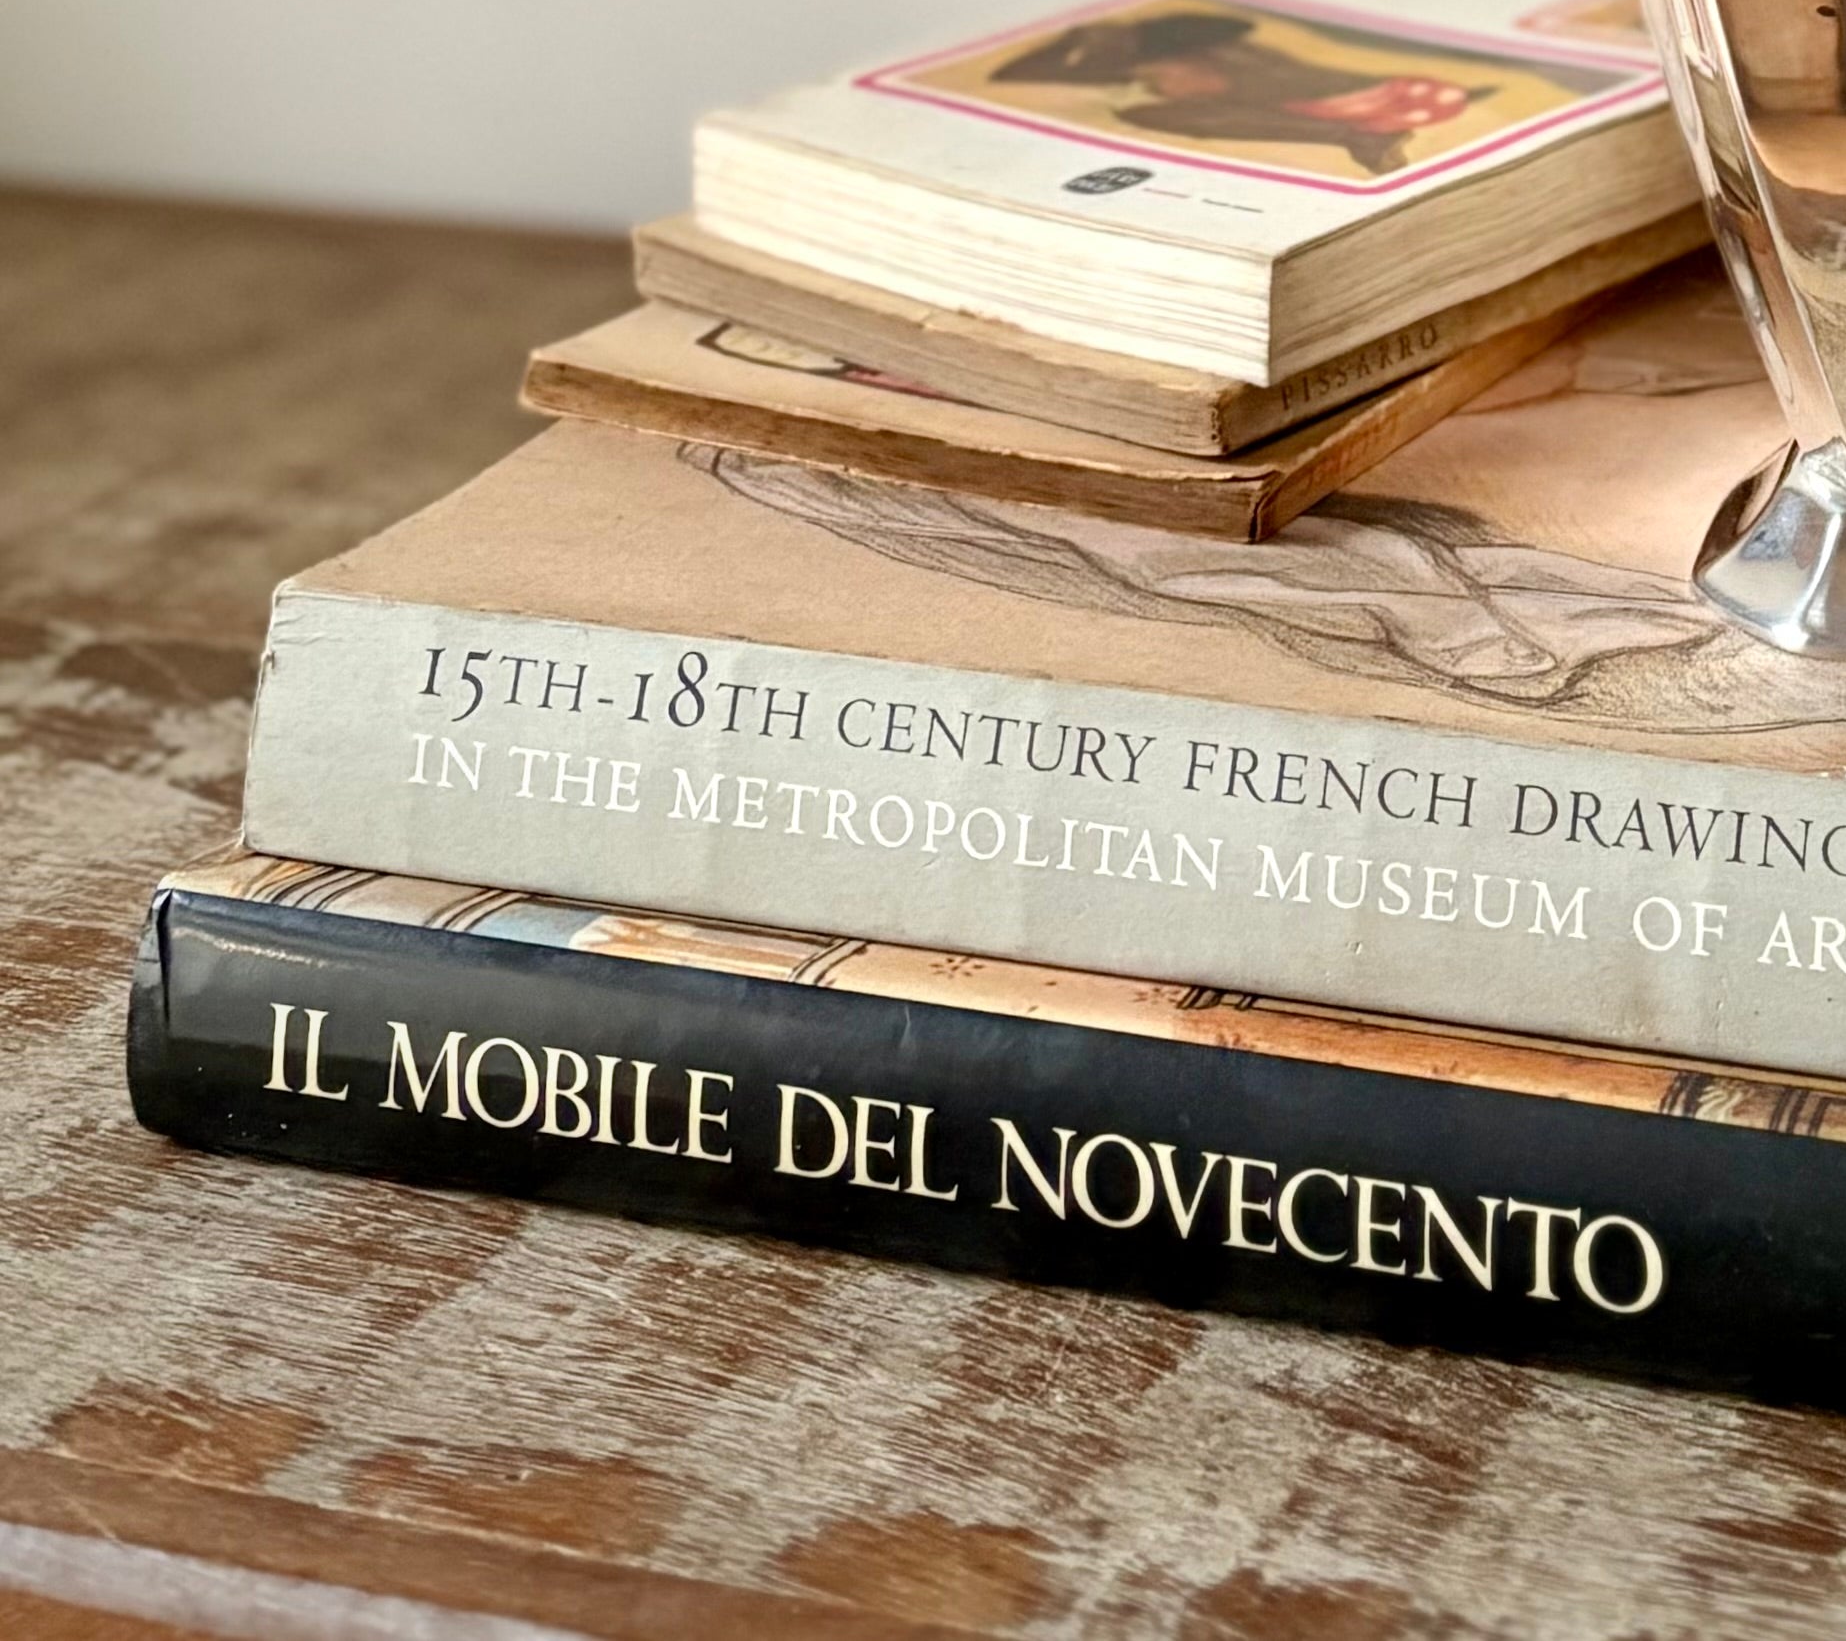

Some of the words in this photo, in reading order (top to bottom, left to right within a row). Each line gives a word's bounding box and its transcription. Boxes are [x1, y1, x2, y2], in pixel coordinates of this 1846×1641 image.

[1281, 324, 1438, 411] PISSARRO
[418, 648, 810, 740] 15TH-18TH
[838, 698, 1157, 785] CENTURY
[1183, 740, 1478, 828] FRENCH
[408, 734, 486, 790] IN
[508, 746, 642, 813] THE
[668, 768, 1220, 891] METROPOLITAN
[1254, 845, 1591, 941] MUSEUM
[1632, 896, 1728, 957] OF
[262, 1002, 349, 1101] IL
[378, 1021, 735, 1164] MOBILE
[774, 1084, 959, 1201] DEL
[990, 1117, 1664, 1314] NOVECENTO
